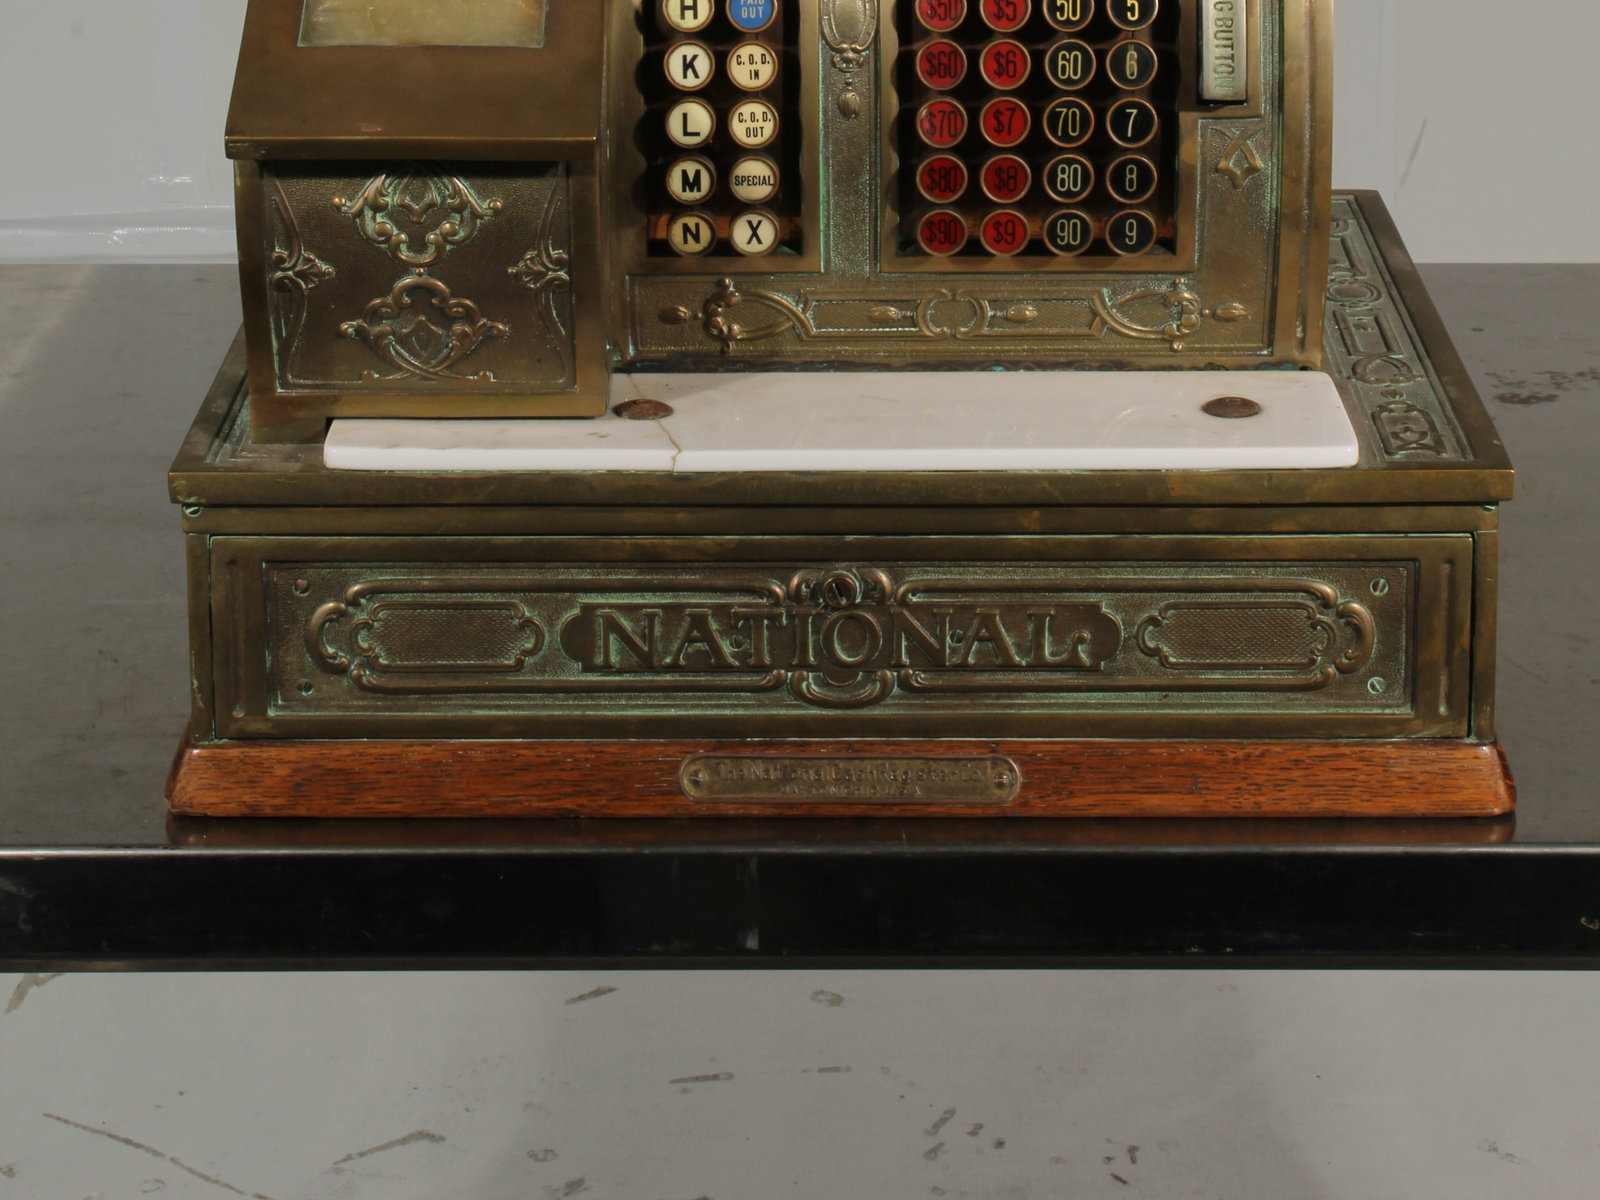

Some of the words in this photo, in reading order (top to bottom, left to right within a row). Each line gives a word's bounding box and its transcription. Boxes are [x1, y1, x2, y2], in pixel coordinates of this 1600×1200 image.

[742, 7, 763, 19] OUT
[682, 55, 700, 79] K
[926, 51, 958, 79] $60
[993, 51, 1017, 78] $6
[1058, 51, 1082, 80] 60
[1126, 51, 1138, 80] 6
[1213, 18, 1235, 90] BUTTON
[749, 69, 759, 80] IN
[682, 112, 700, 136] L
[745, 127, 764, 137] OUT
[927, 109, 958, 138] $70
[993, 108, 1017, 136] $7
[1055, 108, 1080, 136] 70
[1126, 109, 1138, 137] 7
[681, 169, 701, 193] M
[734, 175, 773, 186] SPECIAL
[928, 165, 958, 192] $80
[994, 165, 1018, 192] $8
[1057, 164, 1081, 192] 80
[1126, 165, 1137, 192] 8
[682, 223, 700, 244] N
[746, 220, 763, 245] X
[927, 220, 958, 245] $90
[993, 220, 1015, 245] $9
[1056, 219, 1081, 245] 90
[1125, 220, 1137, 245] 9
[598, 608, 1091, 668] NATIONAL
